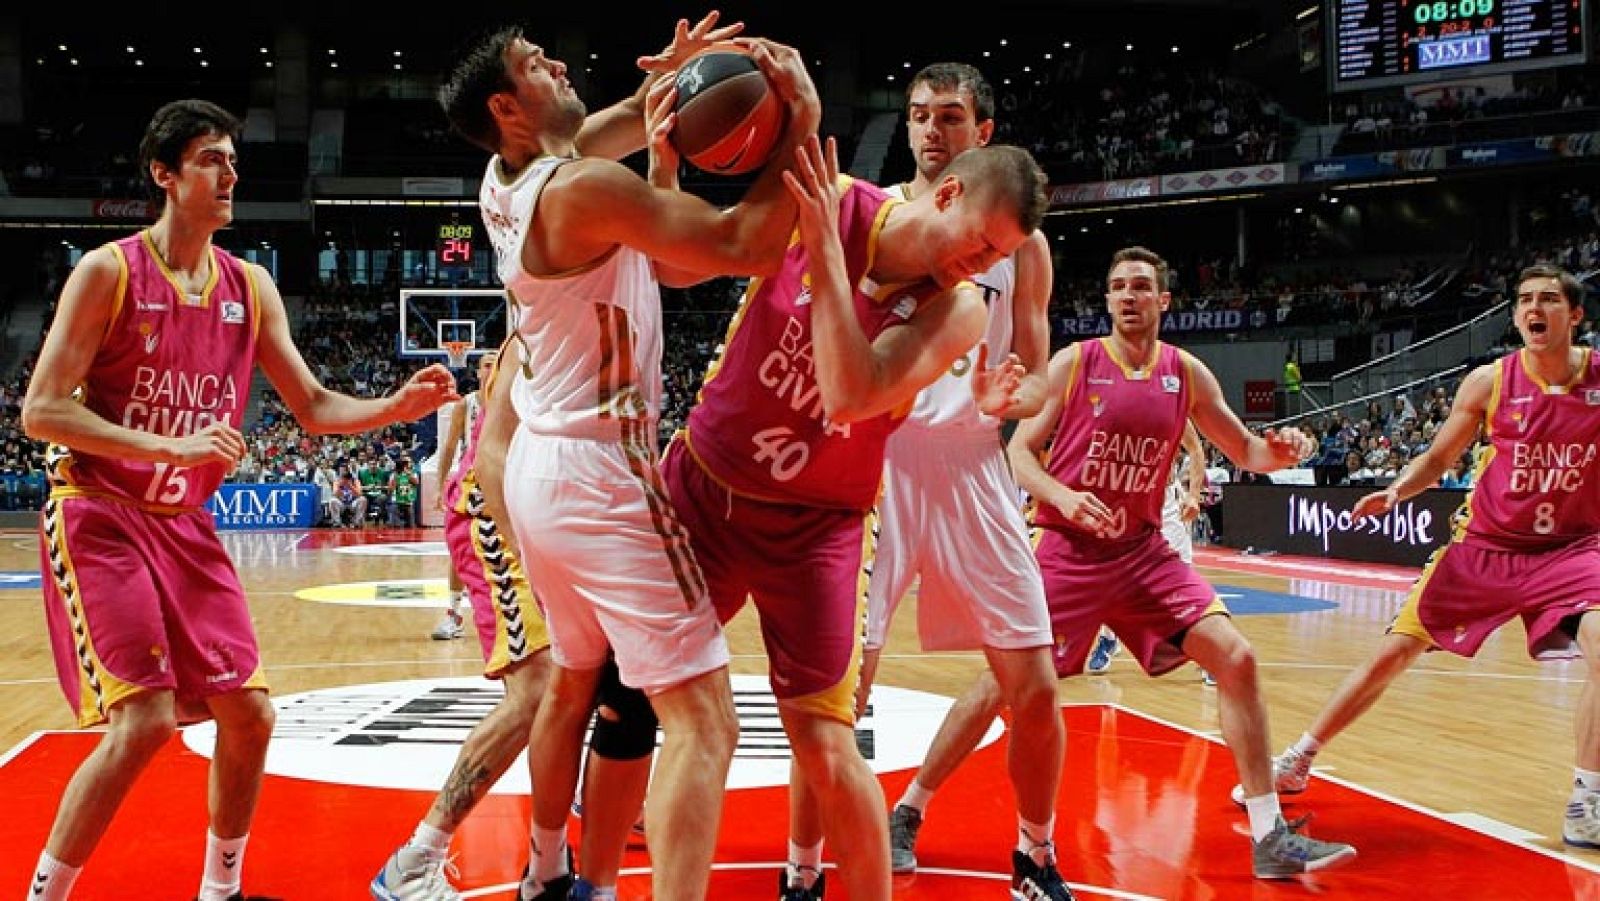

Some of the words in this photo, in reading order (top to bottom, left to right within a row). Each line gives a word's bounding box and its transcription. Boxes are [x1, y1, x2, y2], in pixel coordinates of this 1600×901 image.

[1415, 0, 1494, 23] 08:09
[1422, 38, 1485, 62] MMT
[443, 241, 470, 261] 24
[1063, 317, 1111, 334] REA
[1162, 310, 1241, 330] ADRID
[131, 366, 237, 409] BANCA
[752, 426, 809, 481] 40
[1086, 431, 1169, 466] BANCA
[1513, 442, 1597, 469] BANCA
[145, 462, 189, 504] 15
[211, 489, 309, 515] MMT
[1533, 502, 1555, 535] 8
